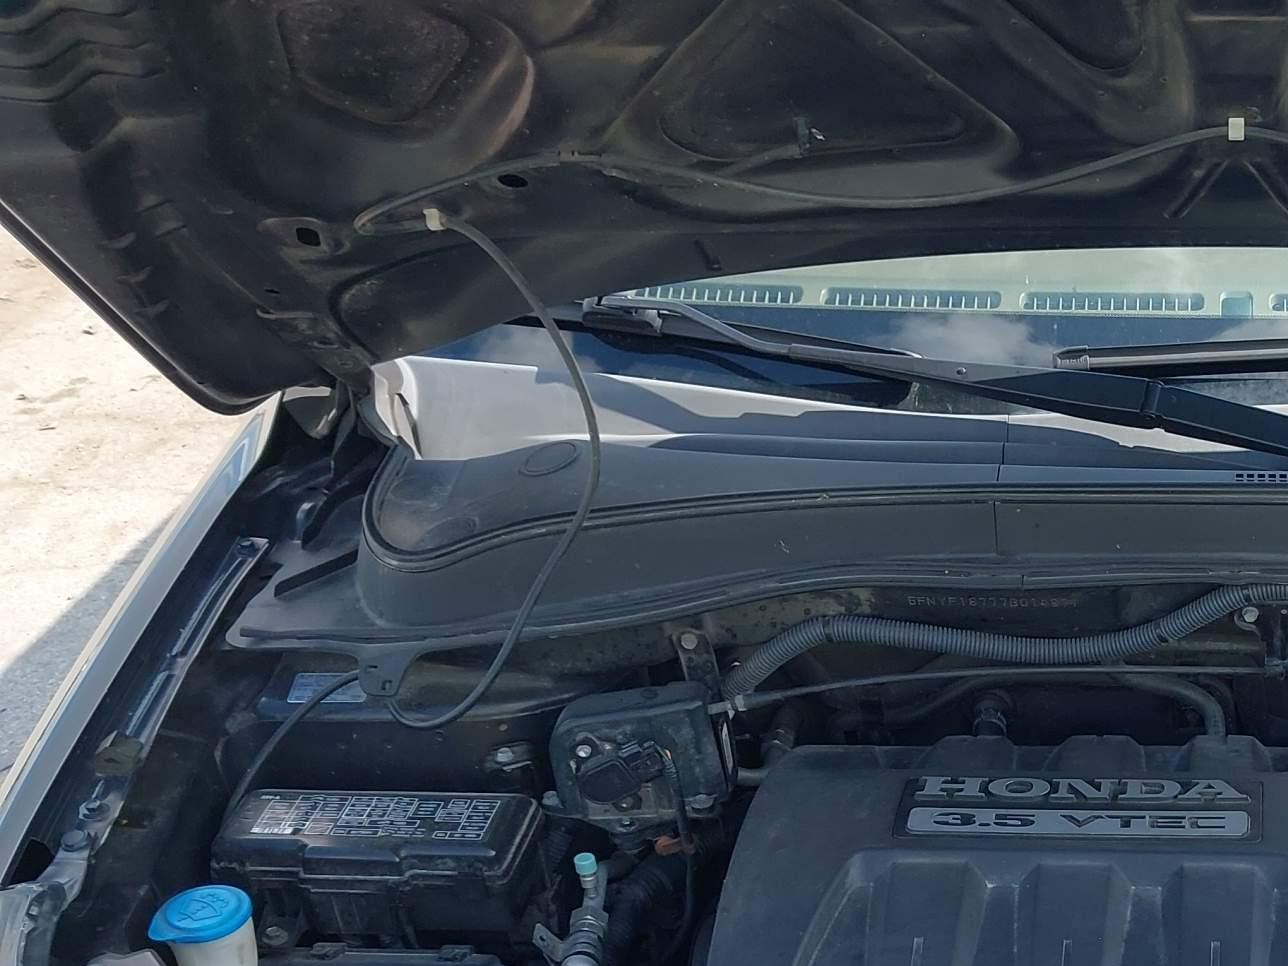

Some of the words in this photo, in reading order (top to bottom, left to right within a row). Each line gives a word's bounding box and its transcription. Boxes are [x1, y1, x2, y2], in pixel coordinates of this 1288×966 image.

[913, 775, 1252, 804] HONDA
[932, 811, 1037, 829] 3.5
[1059, 813, 1227, 830] VTEC
